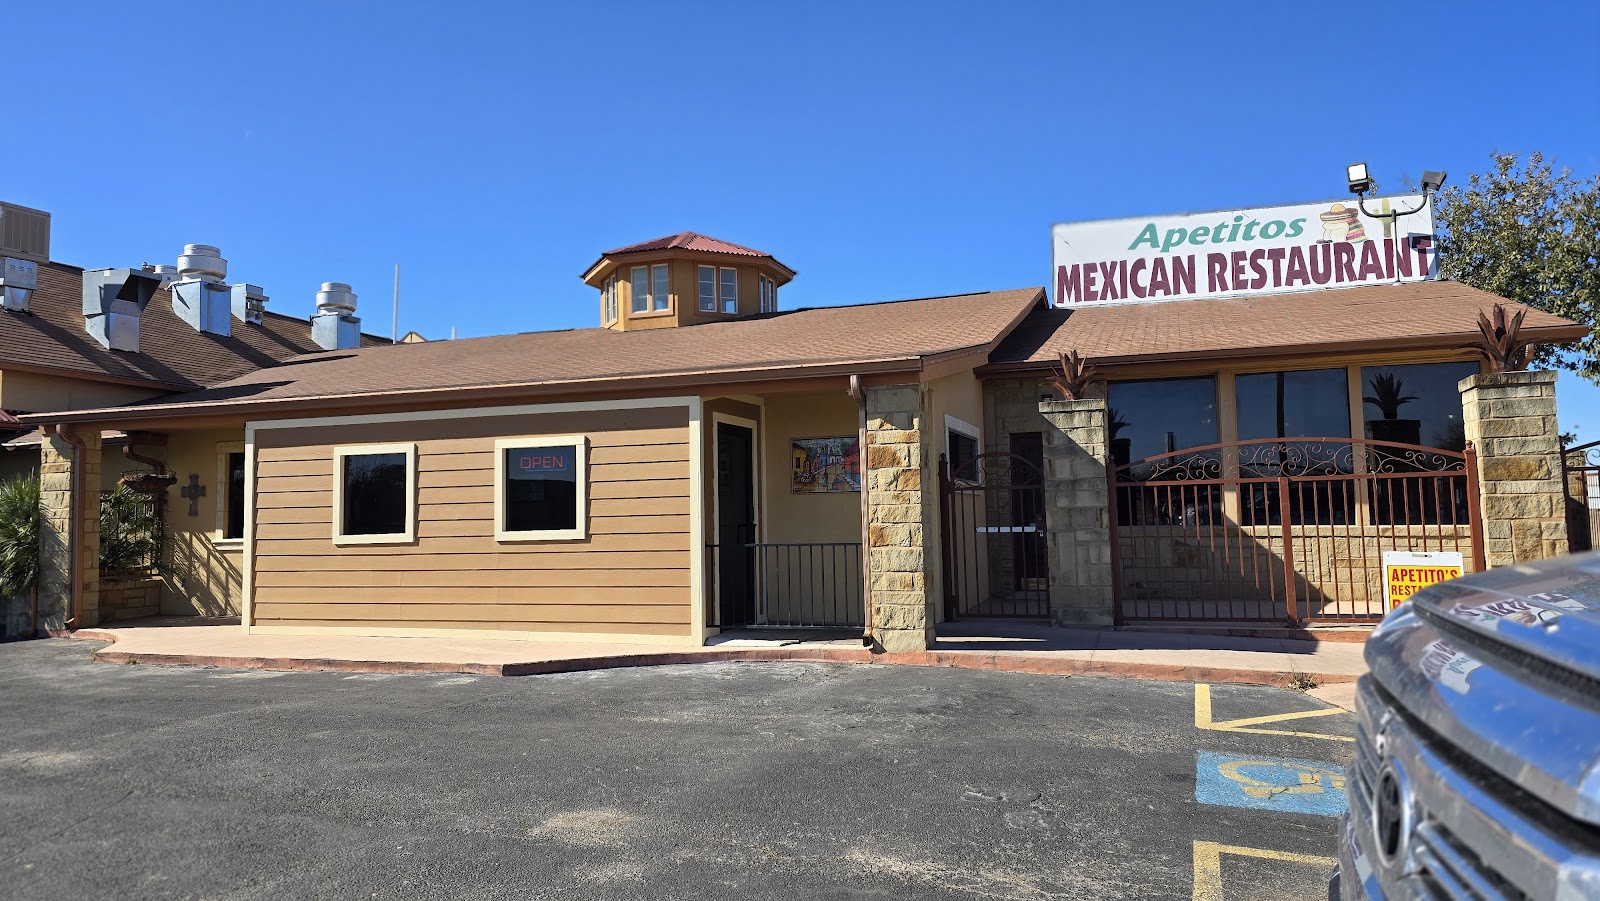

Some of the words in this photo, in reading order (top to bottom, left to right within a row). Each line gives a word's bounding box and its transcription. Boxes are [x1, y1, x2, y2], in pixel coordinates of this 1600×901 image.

[1128, 215, 1307, 253] Apetitos
[1056, 254, 1196, 304] MEXICAN
[1207, 235, 1432, 293] RESTAURANT
[520, 456, 563, 469] OPEN
[1391, 568, 1458, 583] APETITO'S
